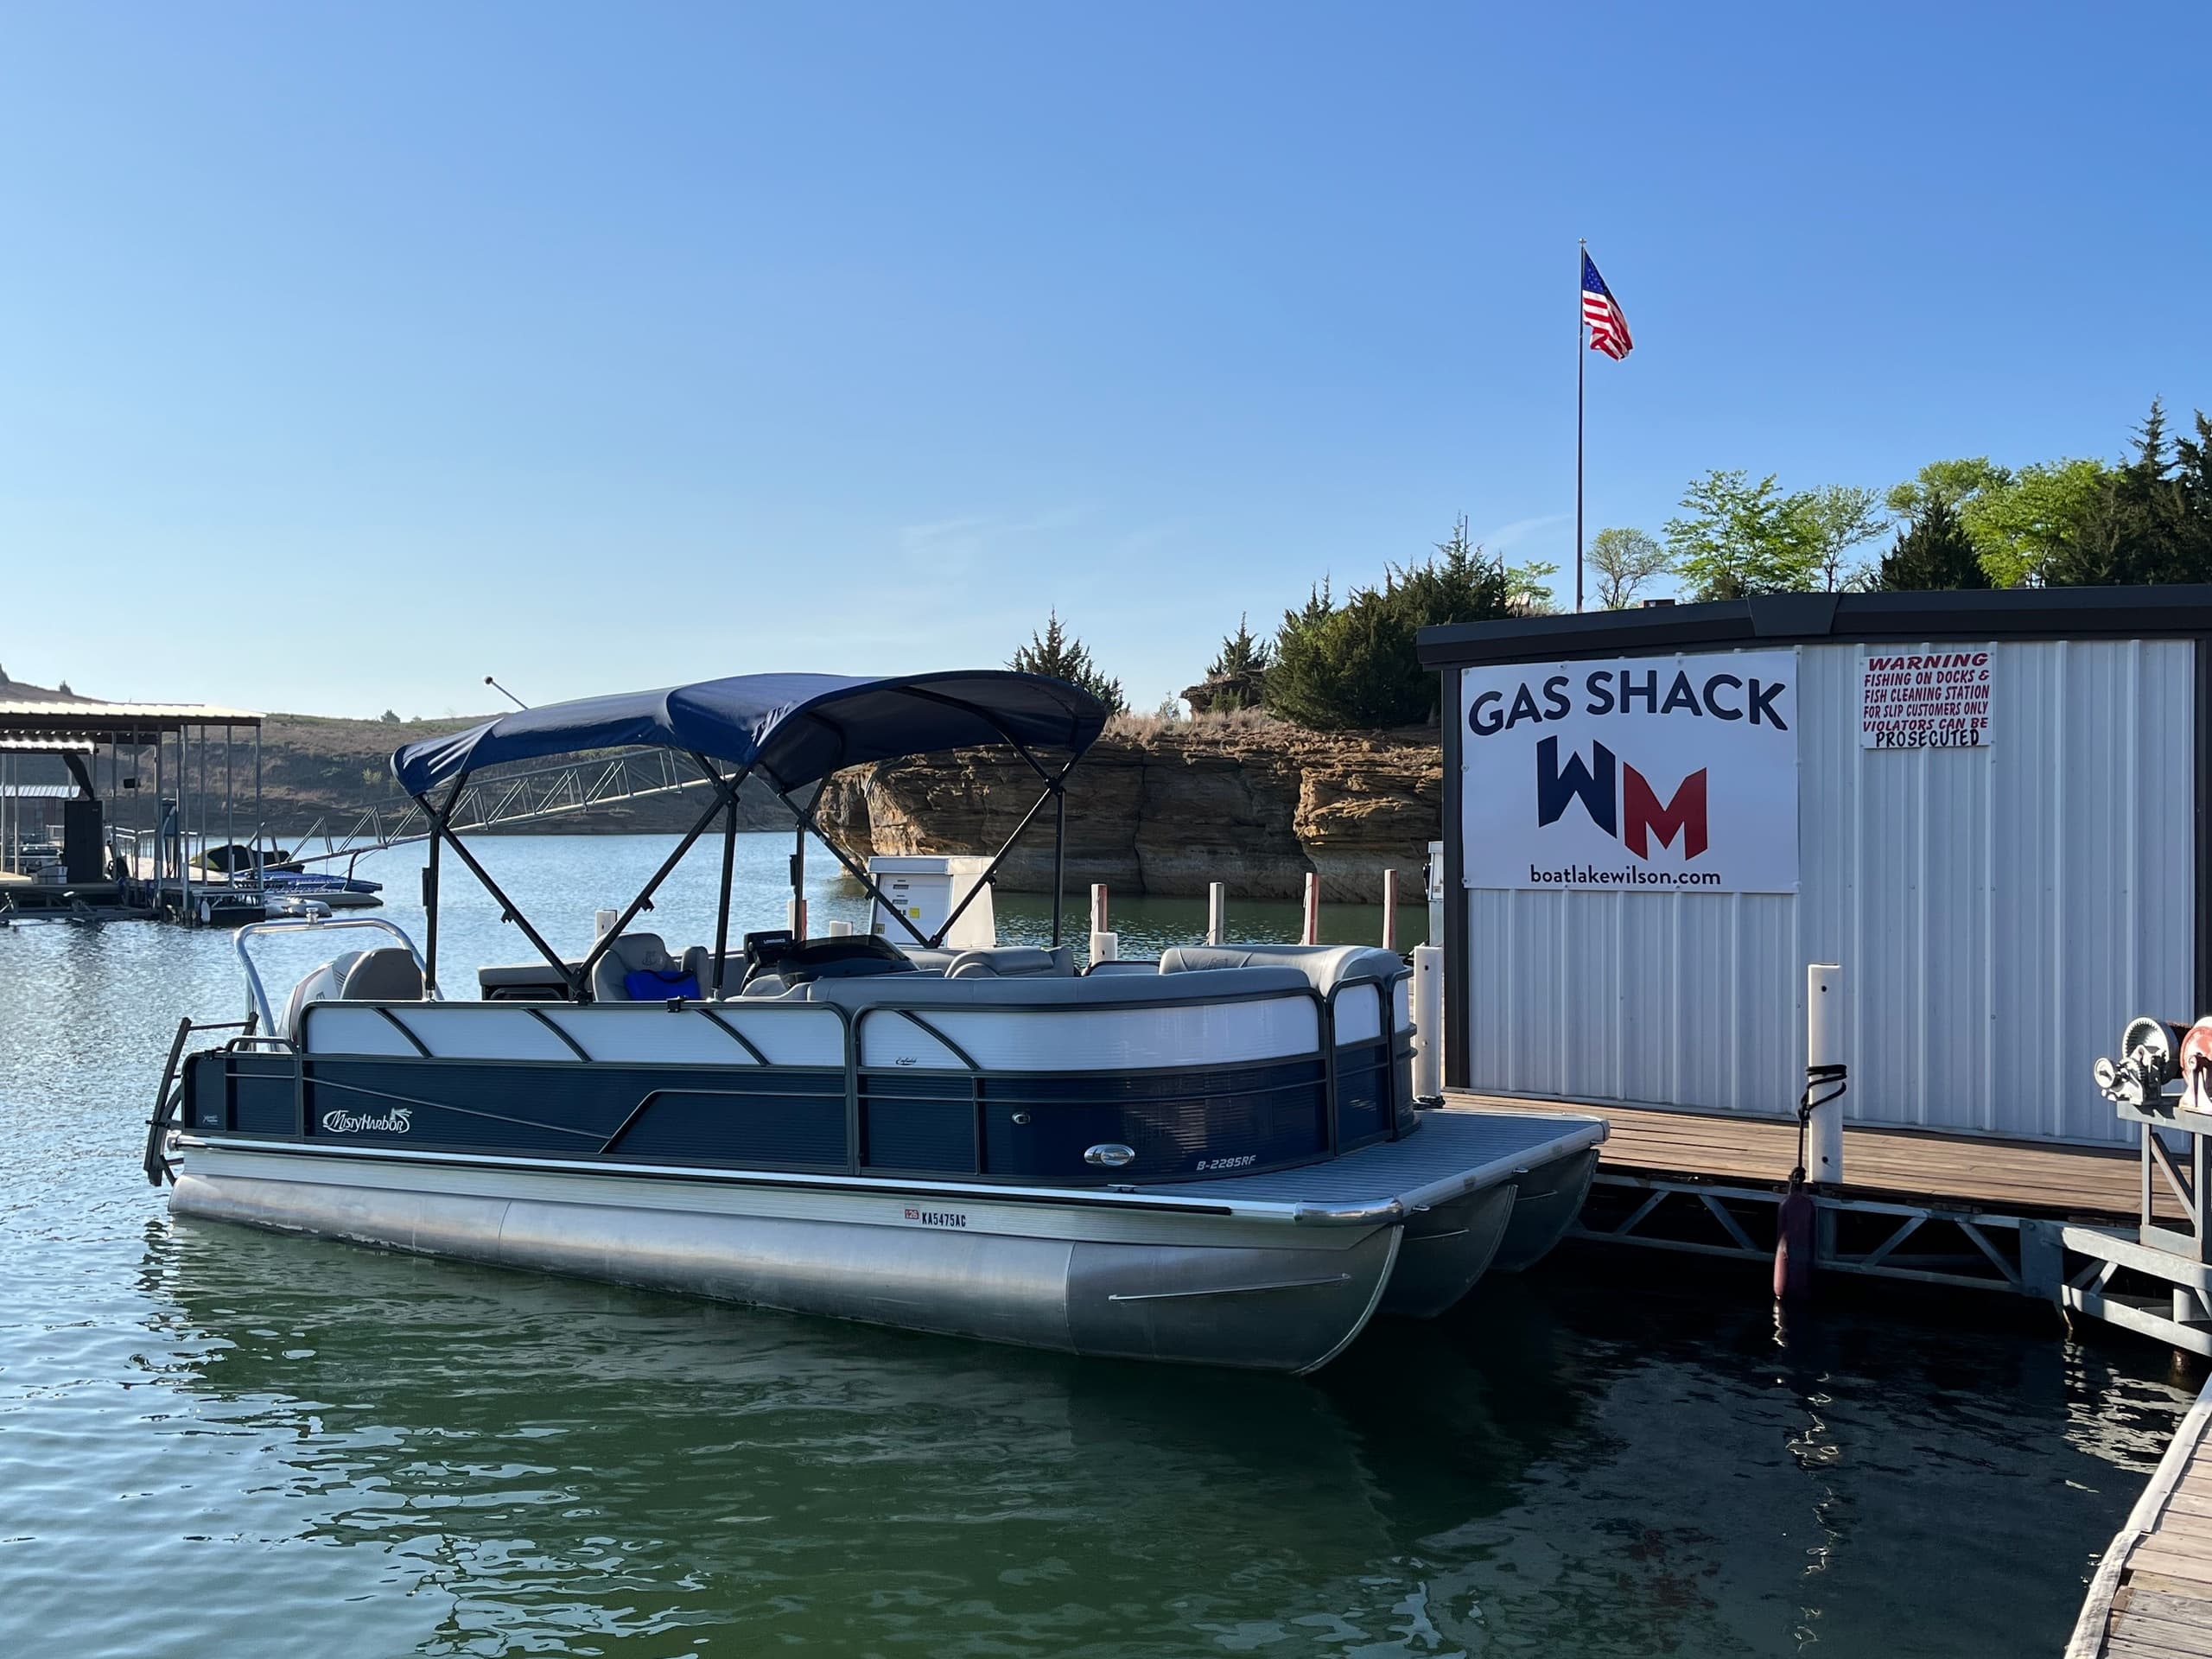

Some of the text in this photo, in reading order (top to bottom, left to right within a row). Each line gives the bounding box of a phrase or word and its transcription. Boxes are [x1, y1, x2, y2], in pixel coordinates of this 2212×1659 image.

[1869, 653, 1988, 671] WARNING
[1865, 670, 1989, 687] FISHING ON DOCKS &
[1865, 684, 1989, 703] FISH CLEANING STATION
[1469, 670, 1789, 736] GAS SHACK
[1864, 701, 1988, 719] FOR SLIP CUSTOMERS ONLY
[1863, 717, 1988, 732] VIOLATORS CAN BE
[1876, 728, 1980, 747] PROSECUTED
[1530, 864, 1721, 886] boatlakewilson.com
